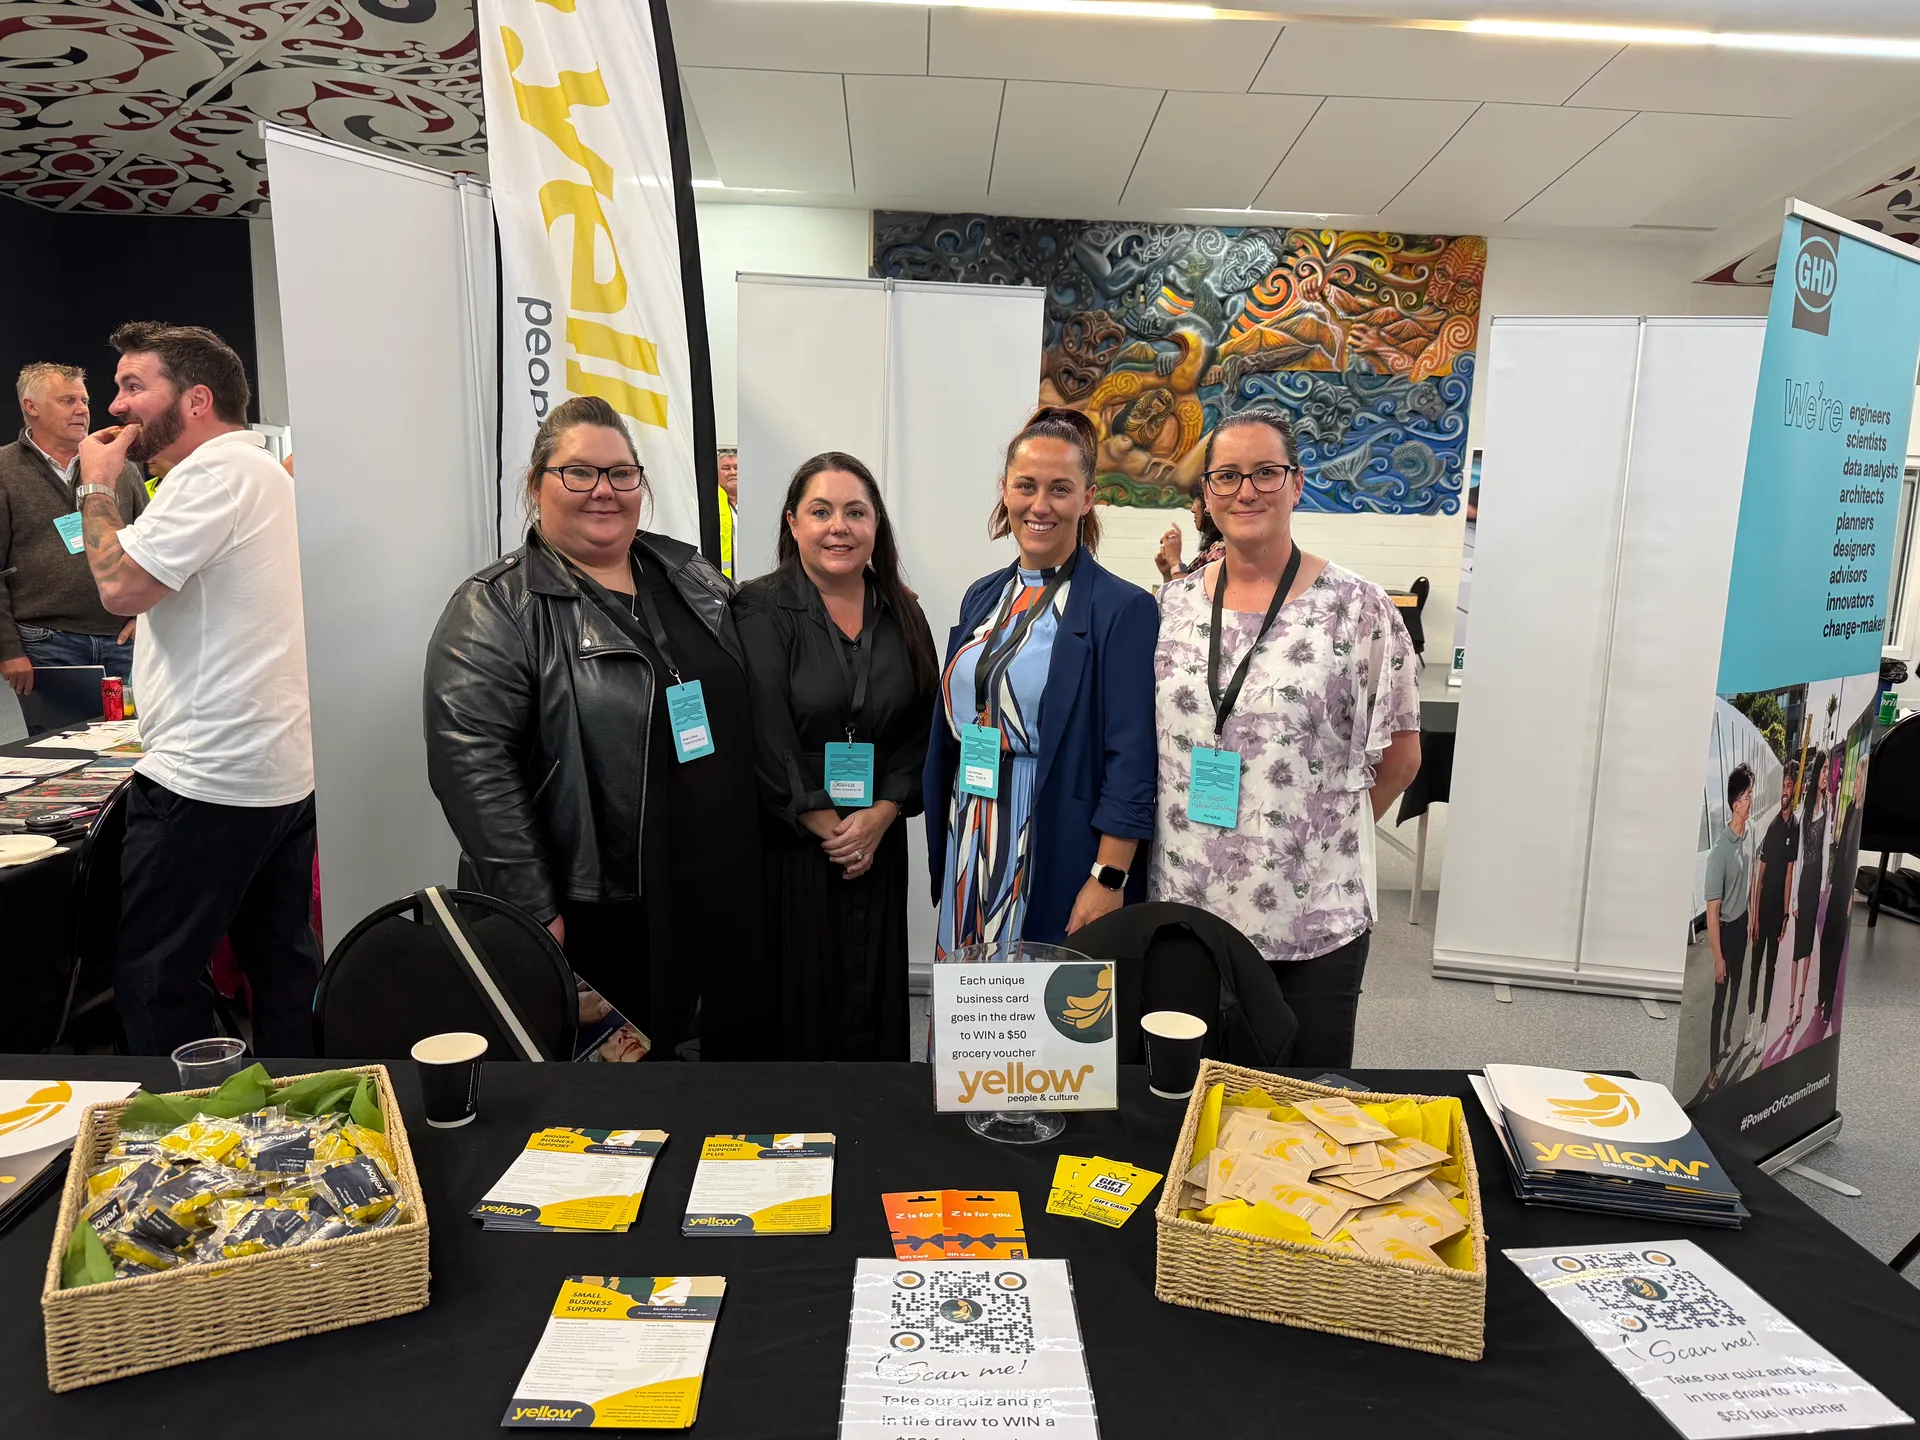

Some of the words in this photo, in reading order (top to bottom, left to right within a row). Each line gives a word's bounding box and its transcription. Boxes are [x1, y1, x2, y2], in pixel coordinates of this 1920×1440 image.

[500, 25, 668, 430] yell
[1798, 253, 1835, 296] GHD
[517, 296, 553, 427] peop
[1850, 403, 1890, 426] engineers
[1846, 431, 1887, 452] scientists
[1843, 457, 1862, 477] data
[1863, 460, 1899, 483] analysts
[1839, 487, 1884, 505] architects
[1836, 511, 1874, 535] planners
[1833, 539, 1875, 561] designers
[1829, 566, 1867, 584] advisors
[1826, 592, 1874, 611] innovators
[960, 976, 986, 985] Each
[988, 976, 1025, 986] unique
[956, 995, 1003, 1004] business
[1006, 994, 1029, 1003] card
[950, 1014, 976, 1024] goes
[978, 1012, 988, 1022] in
[990, 1012, 1007, 1021] the
[1009, 1012, 1036, 1021] draw
[960, 1032, 971, 1040] to
[973, 1031, 996, 1040] WIN
[1007, 1030, 1027, 1040] $50
[952, 1050, 991, 1060] grocery
[993, 1048, 1036, 1058] voucher
[958, 1062, 1094, 1104] yellow
[1007, 1094, 1038, 1103] people
[1740, 1073, 1831, 1132] #PowerOfCommitment
[1531, 1142, 1710, 1178] yellow
[360, 1162, 388, 1194] yellow
[1602, 1162, 1644, 1172] people
[1658, 1170, 1700, 1181] culture
[1095, 1183, 1122, 1194] CARD
[1098, 1178, 1126, 1188] GIFT
[477, 1204, 532, 1215] yellow
[1110, 1203, 1130, 1212] CARD
[688, 1216, 742, 1226] yellow
[1648, 1340, 1717, 1364] Scan
[1721, 1330, 1760, 1351] me!
[979, 1359, 1028, 1378] me!
[1664, 1374, 1703, 1386] Take
[1704, 1372, 1730, 1382] our
[1732, 1368, 1764, 1384] quiz
[1765, 1366, 1796, 1377] and
[882, 1395, 920, 1406] Take
[924, 1398, 953, 1406] our
[958, 1396, 993, 1408] quiz
[997, 1396, 1028, 1406] and
[1033, 1398, 1053, 1408] go
[1686, 1392, 1704, 1403] in
[1704, 1390, 1732, 1402] the
[1732, 1388, 1771, 1401] draw
[1772, 1386, 1790, 1396] to
[512, 1406, 582, 1420] yellow
[902, 1416, 930, 1426] the
[934, 1416, 977, 1426] draw
[982, 1418, 999, 1427] to
[1002, 1416, 1040, 1427] WIN
[1045, 1418, 1056, 1427] a
[1717, 1408, 1750, 1422] $50
[1749, 1406, 1780, 1421] fuel
[1782, 1402, 1848, 1417] voucher
